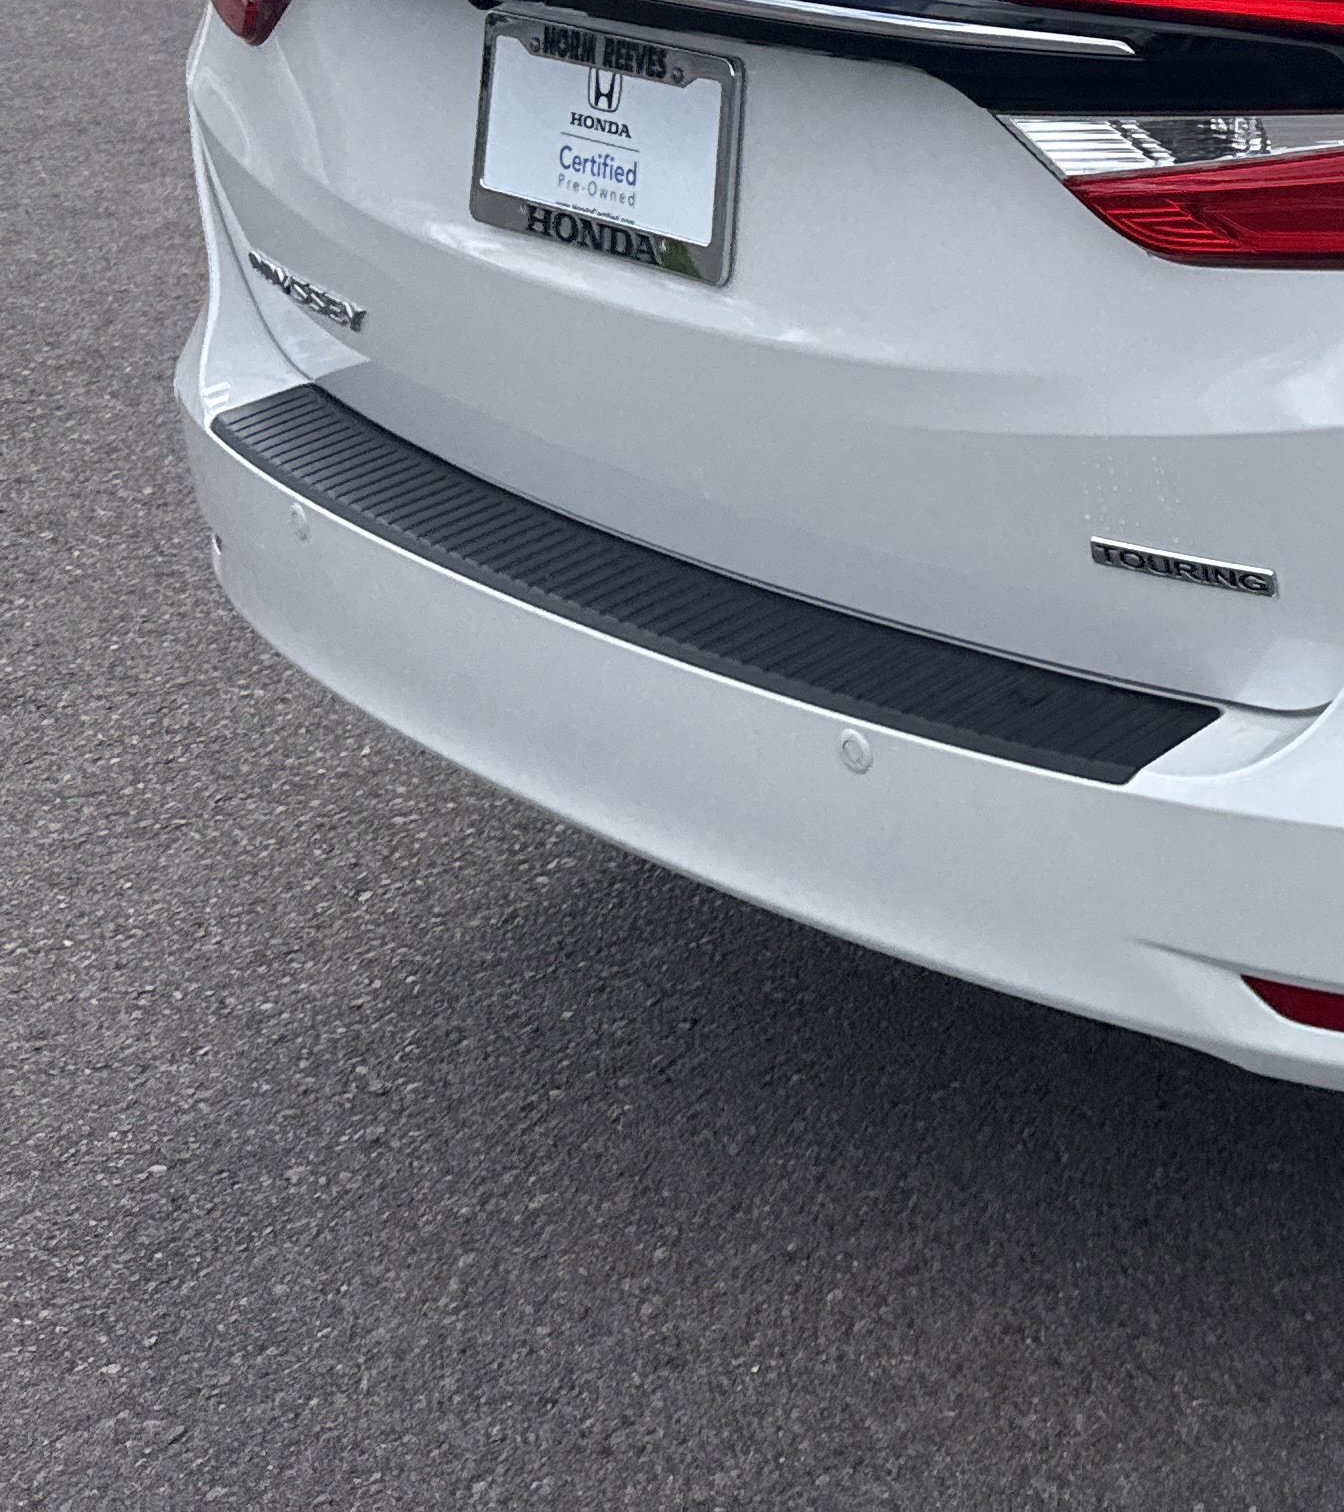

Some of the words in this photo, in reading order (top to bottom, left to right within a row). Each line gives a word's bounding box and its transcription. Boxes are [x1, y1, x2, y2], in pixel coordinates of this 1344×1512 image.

[543, 24, 597, 64] NORM
[603, 37, 667, 79] REEVES
[570, 112, 632, 139] HONDA
[559, 145, 638, 186] Certified
[558, 173, 636, 207] Pre-Owned
[527, 204, 662, 266] HONDA
[1095, 543, 1271, 592] TOURING
